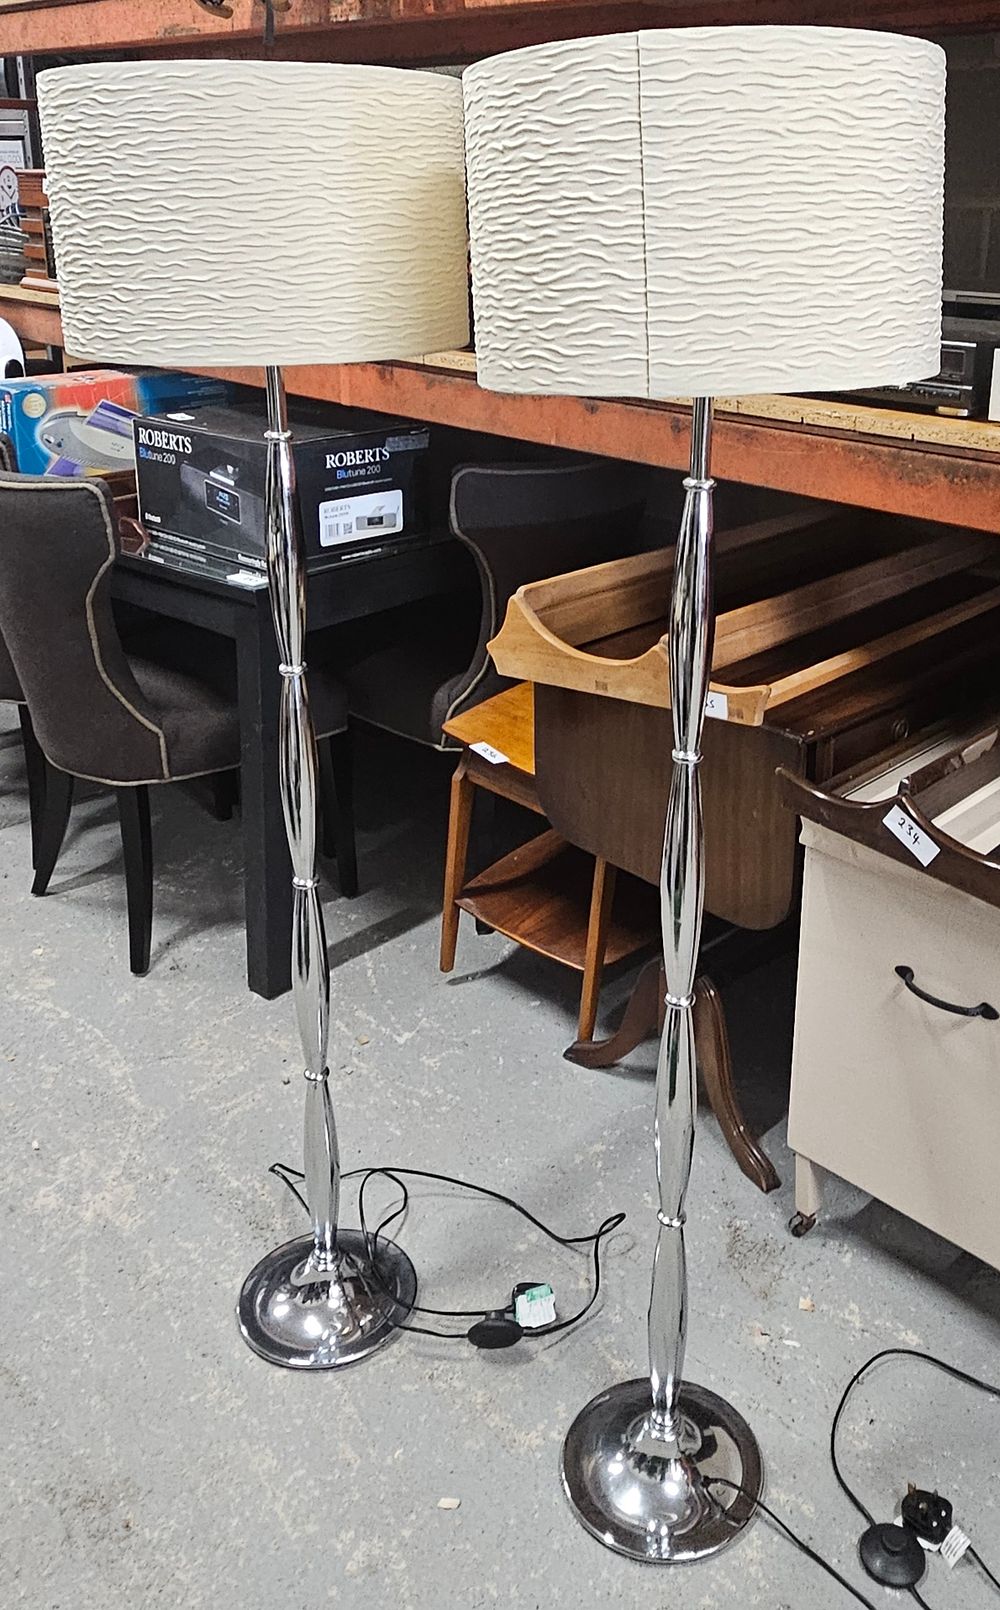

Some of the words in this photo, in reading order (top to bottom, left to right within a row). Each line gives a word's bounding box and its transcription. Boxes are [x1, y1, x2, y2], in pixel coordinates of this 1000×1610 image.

[138, 427, 192, 454] ROBERTS
[139, 446, 163, 462] Blutune
[163, 452, 176, 465] 200
[325, 447, 390, 469] ROBERTS
[336, 467, 366, 480] Blutune
[366, 464, 381, 475] 200
[897, 817, 920, 845] 234
